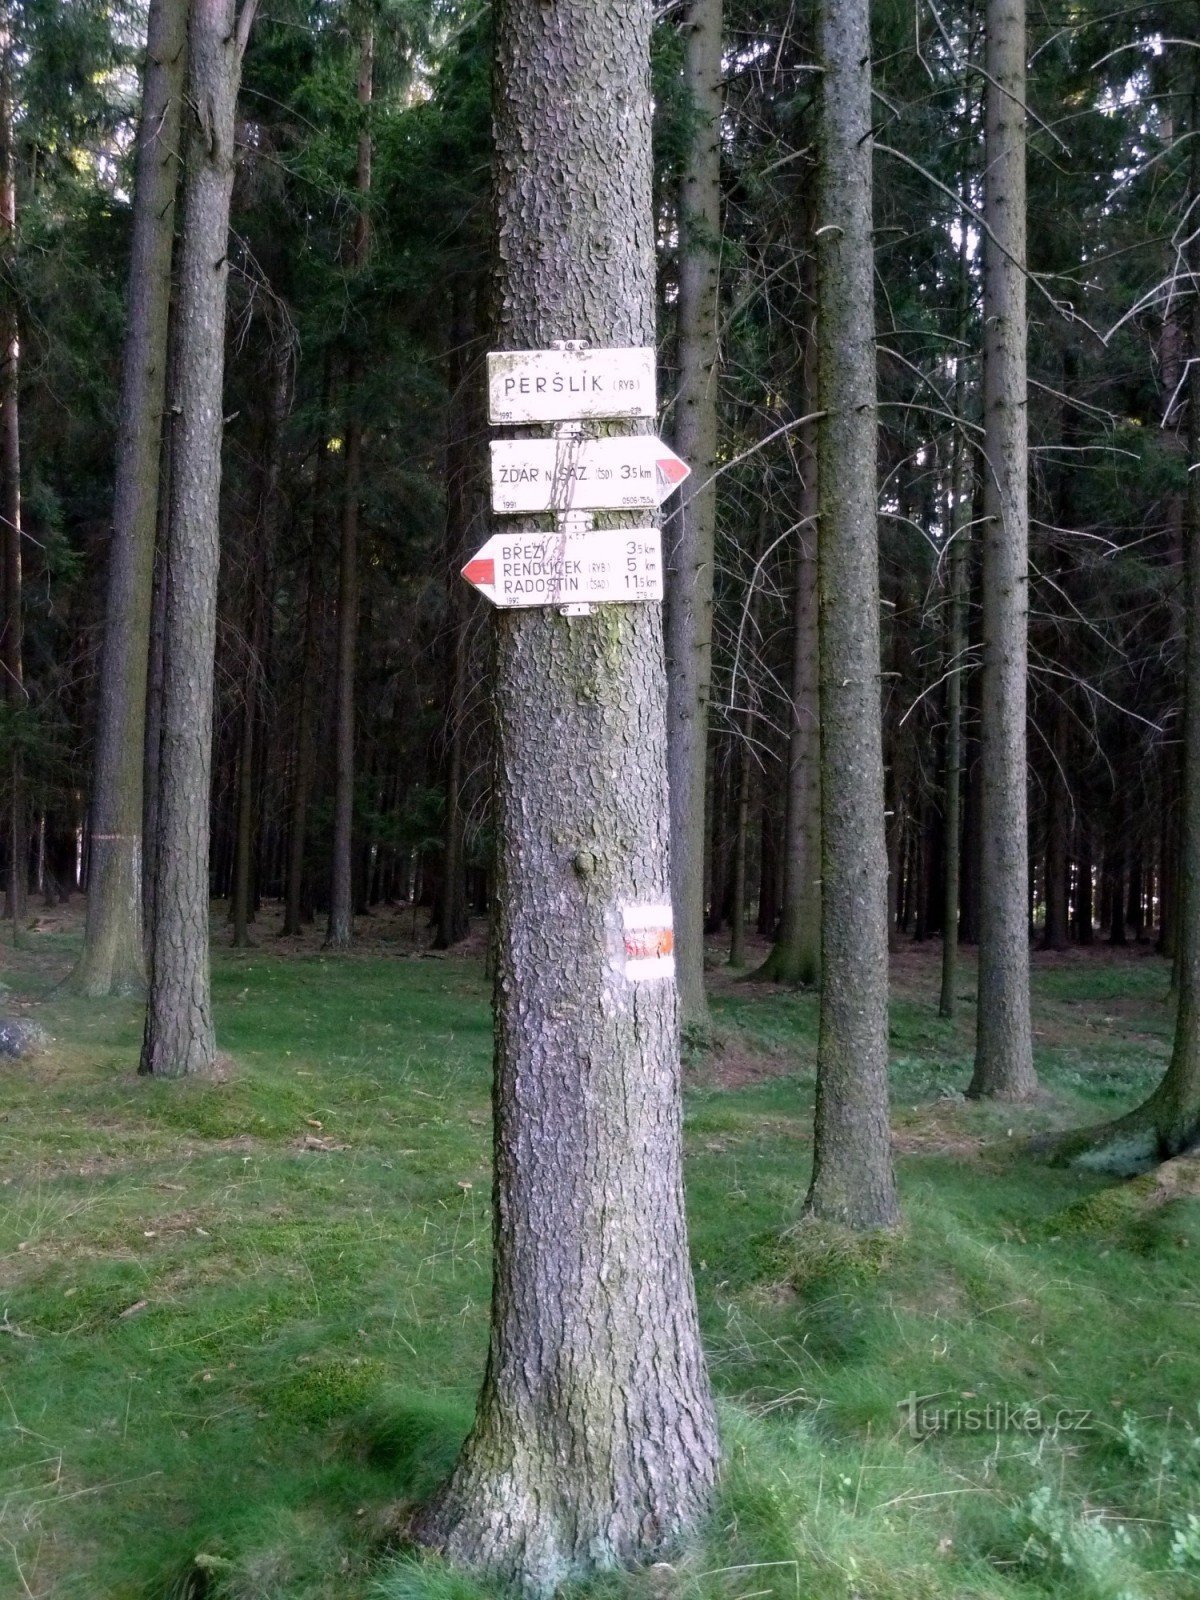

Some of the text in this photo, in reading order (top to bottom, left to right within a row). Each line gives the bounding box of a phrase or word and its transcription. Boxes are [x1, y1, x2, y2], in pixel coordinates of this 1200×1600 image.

[505, 371, 640, 395] PERŠLÍK (RYB)
[639, 464, 652, 479] km
[644, 543, 656, 554] km
[626, 557, 637, 571] 5
[645, 558, 656, 571] km
[504, 575, 579, 594] RADOSTÍN
[646, 576, 657, 587] km
